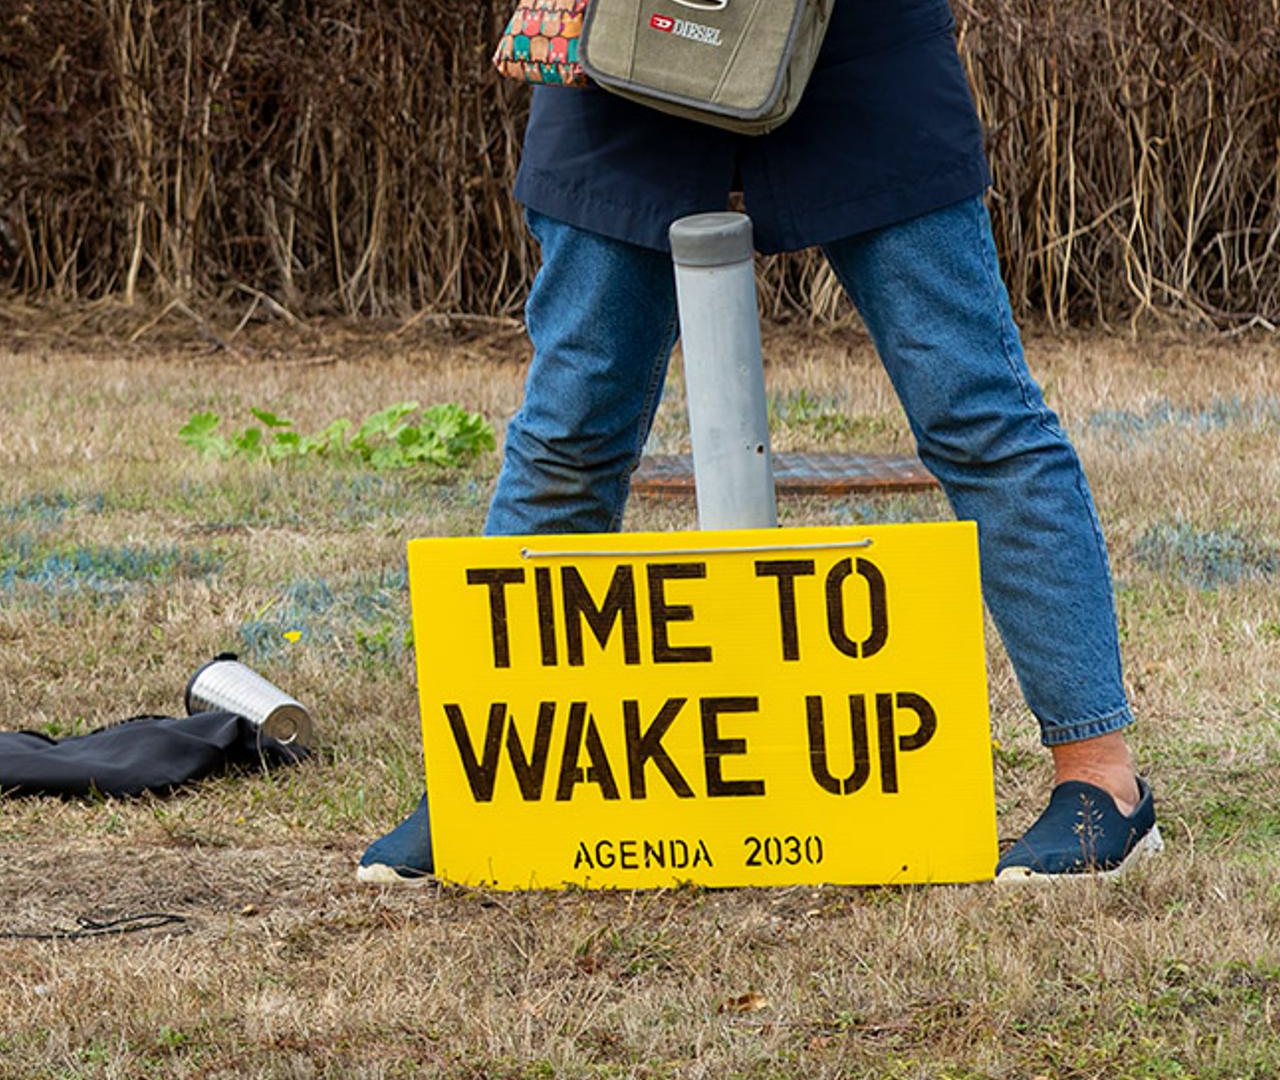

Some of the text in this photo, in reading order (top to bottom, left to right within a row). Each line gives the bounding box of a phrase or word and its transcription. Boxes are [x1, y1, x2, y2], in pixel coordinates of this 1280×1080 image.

[672, 18, 722, 46] DIESEL
[465, 557, 889, 669] TIME TO
[443, 691, 937, 803] WAKE UP
[573, 835, 824, 870] AGENDA 2030
